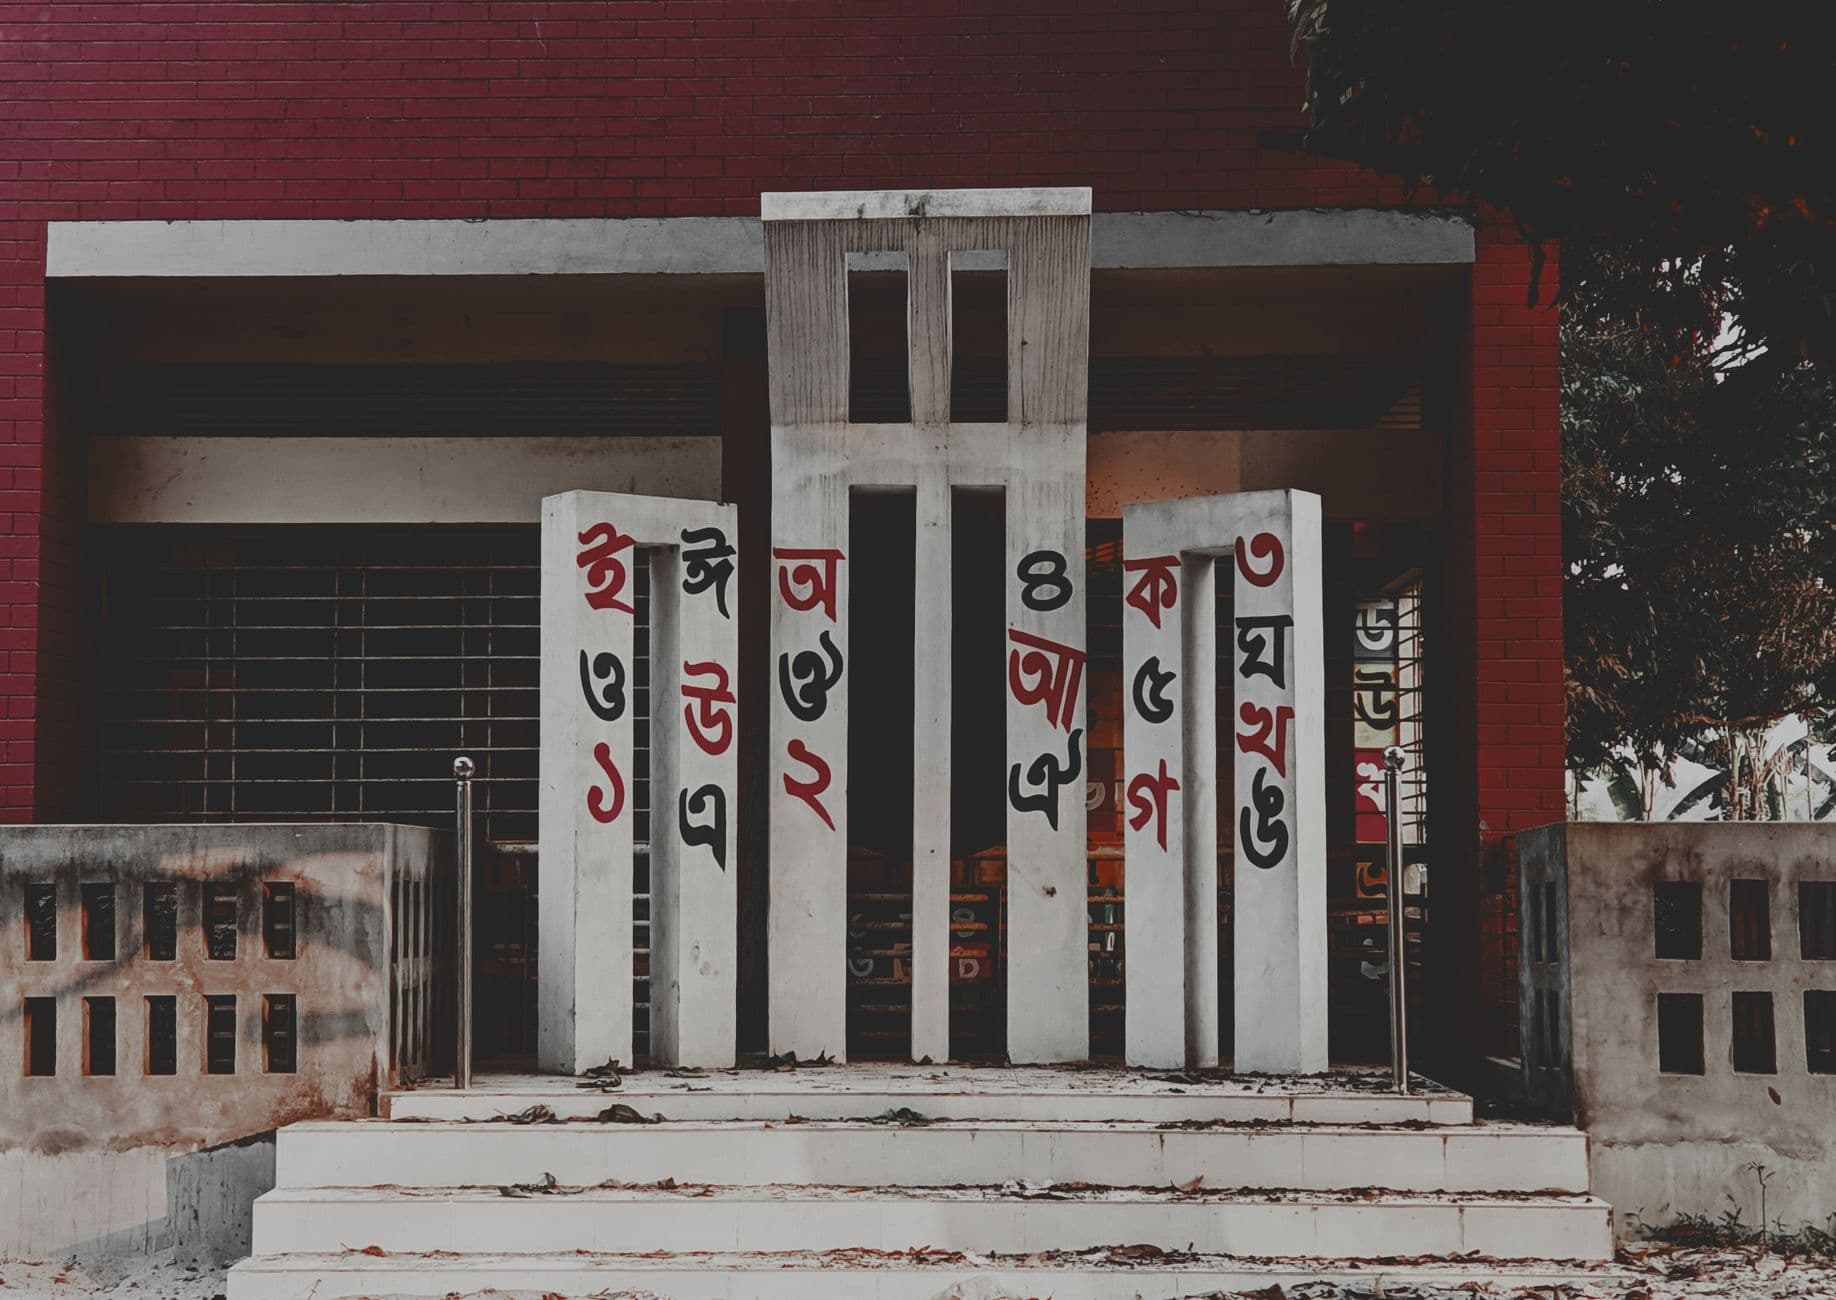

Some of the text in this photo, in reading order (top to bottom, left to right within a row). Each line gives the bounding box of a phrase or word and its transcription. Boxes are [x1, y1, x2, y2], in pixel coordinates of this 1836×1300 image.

[773, 547, 846, 623] অ
[1017, 550, 1073, 612] ৪
[1123, 555, 1182, 629] ক
[580, 649, 626, 721] ও
[779, 630, 844, 722] ঔ
[1008, 629, 1087, 734] আ
[1132, 656, 1177, 724] ৫
[1236, 614, 1294, 689] ঘ
[681, 660, 736, 756] উ
[1236, 702, 1295, 779] খ
[587, 742, 625, 823] ১
[783, 739, 836, 832] ২
[1008, 728, 1083, 831] ঐ
[1127, 758, 1180, 852] গ
[1240, 767, 1289, 869] ঙ
[679, 784, 727, 872] এ
